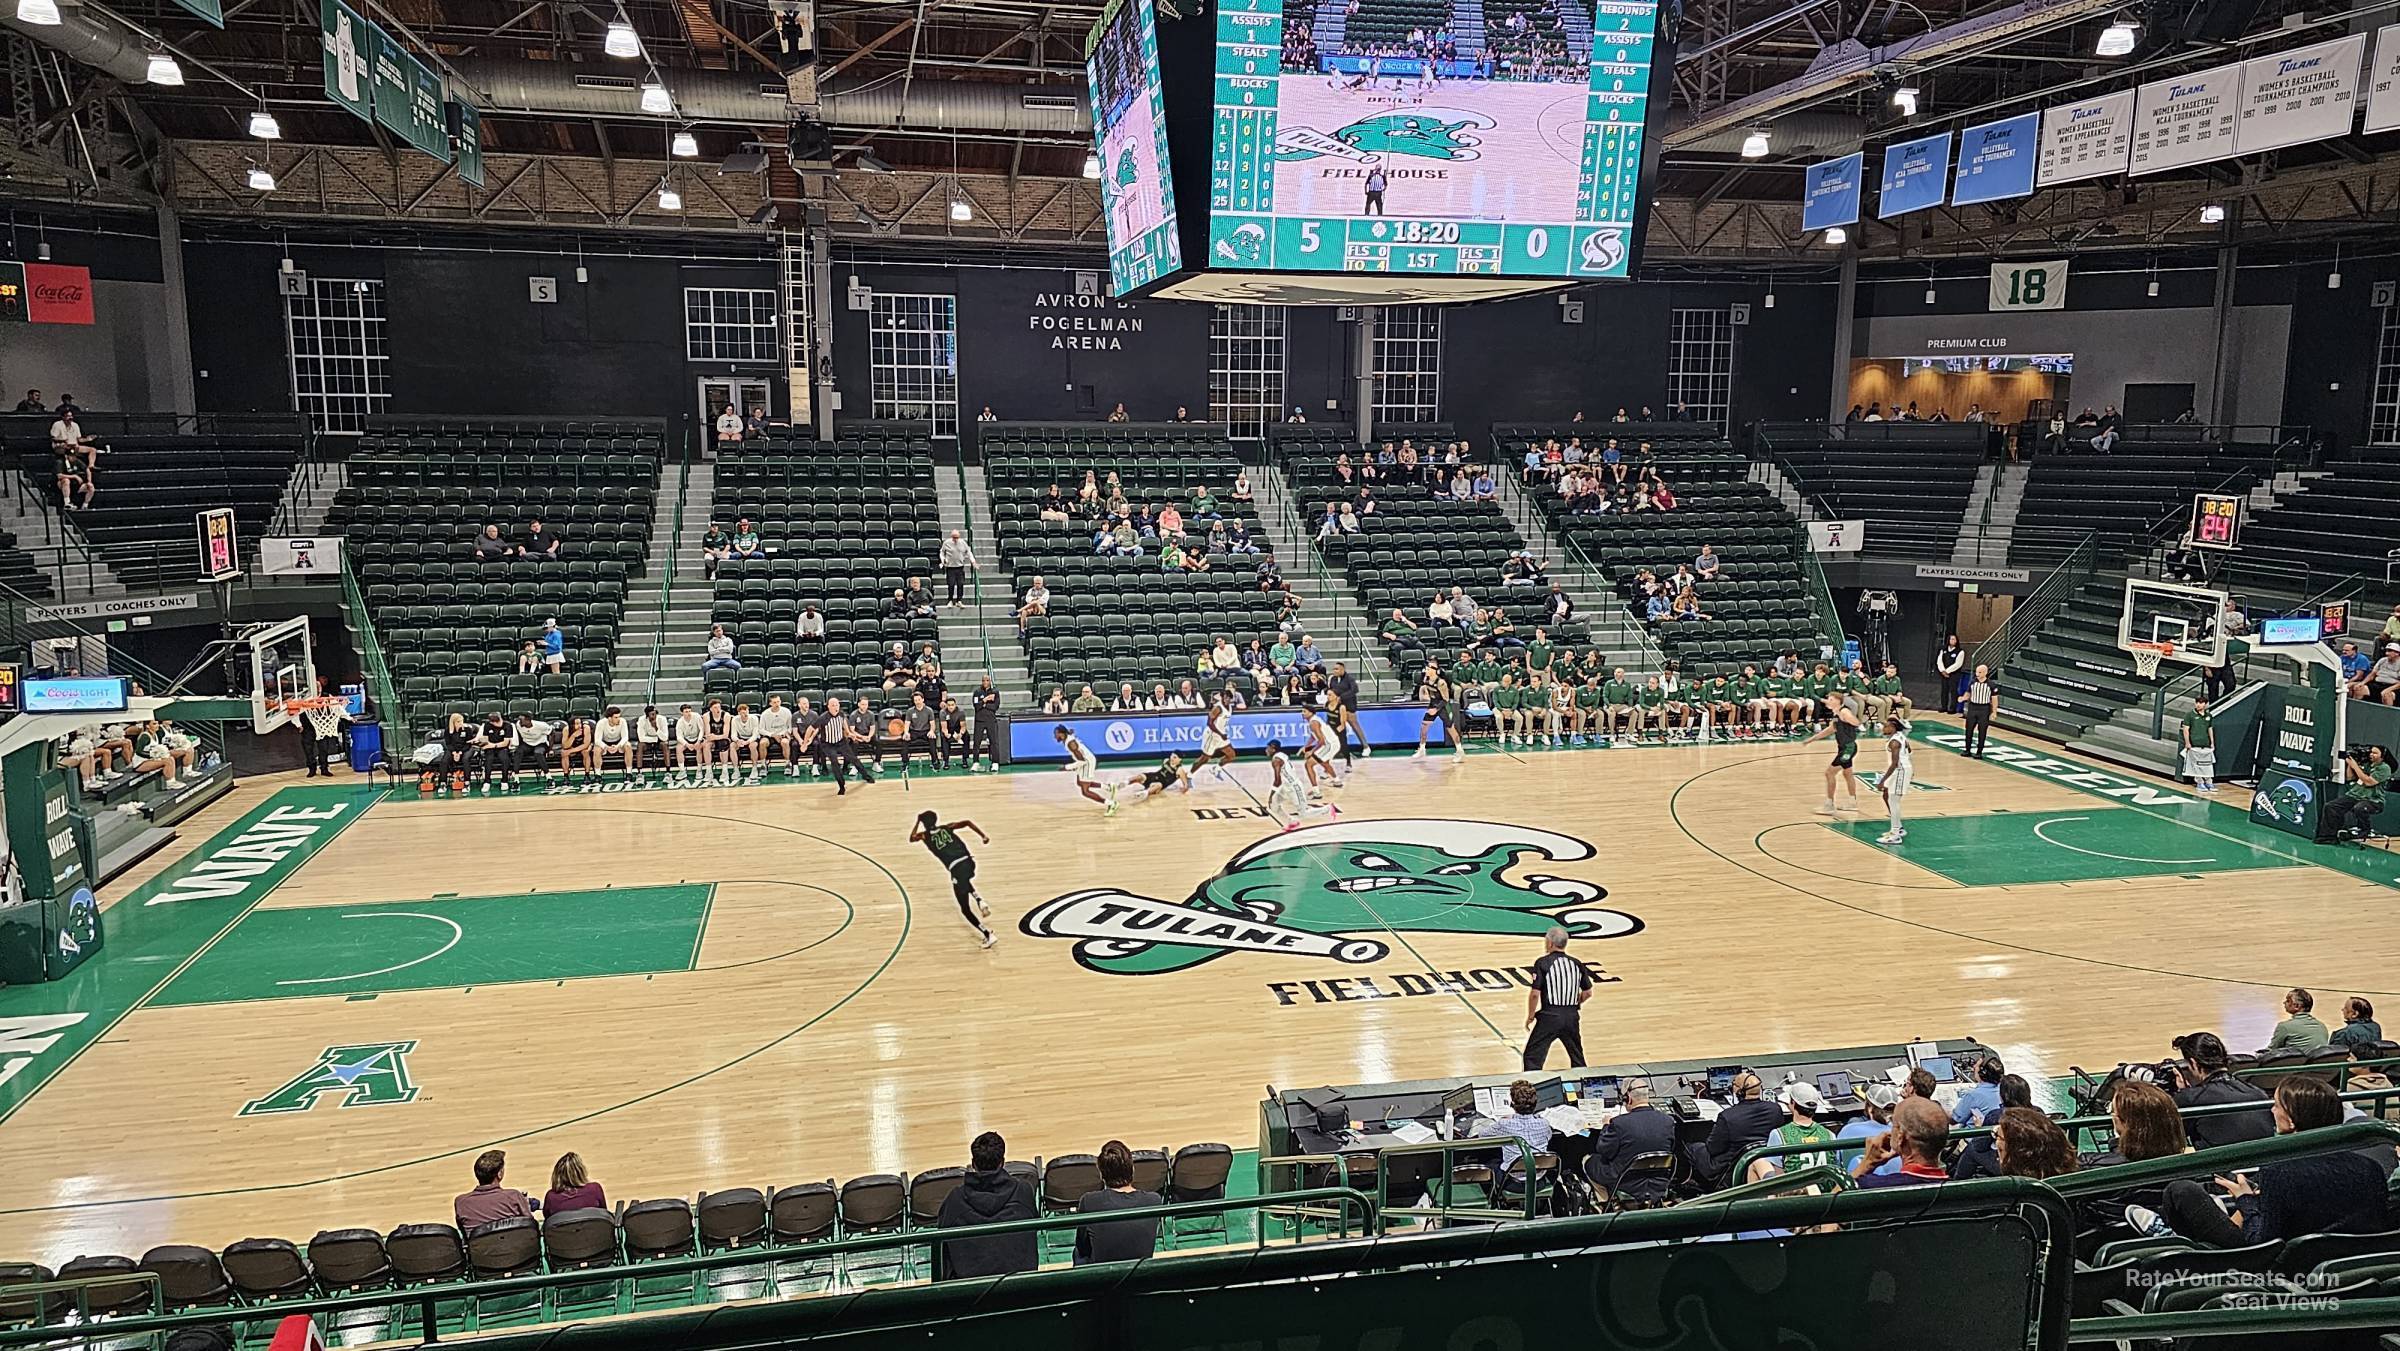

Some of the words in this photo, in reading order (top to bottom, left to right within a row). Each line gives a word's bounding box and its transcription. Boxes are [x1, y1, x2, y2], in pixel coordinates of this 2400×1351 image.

[1601, 5, 1652, 16] REBOUNDS
[1231, 16, 1271, 26] ASSISTS
[1620, 18, 1629, 31] 2
[1247, 29, 1255, 41] 1
[1604, 35, 1641, 45] ASSISTS
[1232, 47, 1268, 57] STEALS
[1616, 49, 1626, 62] 0
[1245, 60, 1255, 73] 0
[1602, 66, 1637, 76] STEALS
[1230, 79, 1269, 89] BLOCKS
[1613, 79, 1623, 92] 0
[2258, 78, 2289, 93] WOMEN'S
[2291, 69, 2336, 86] BASKETBALL
[2375, 81, 2391, 93] 1997
[1244, 92, 1254, 104] 0
[2253, 87, 2296, 105] TOURNAMENT
[2298, 79, 2340, 95] CHAMPIONS
[1599, 95, 1635, 104] BLOCKS
[2152, 104, 2180, 117] WOMEN'S
[2181, 95, 2219, 111] BASKETBALL
[2285, 100, 2302, 112] 2000
[2334, 90, 2351, 101] 2010
[1219, 109, 1232, 119] PL
[1241, 110, 1254, 119] PT
[1265, 111, 1272, 120] F
[1609, 108, 1619, 121] 0
[2156, 115, 2171, 125] NCAA
[2174, 106, 2214, 122] TOURNAMENT
[1220, 124, 1226, 134] 1
[1243, 125, 1251, 136] 0
[1265, 126, 1272, 136] 0
[1585, 125, 1597, 134] PL
[1606, 125, 1619, 135] PT
[1629, 126, 1637, 135] F
[2057, 124, 2081, 136] WOMEN'S
[2082, 117, 2114, 131] BASKETBALL
[1219, 142, 1226, 153] 5
[1243, 144, 1250, 154] 0
[1265, 144, 1271, 154] 0
[1586, 139, 1592, 149] 1
[1607, 140, 1615, 150] 0
[1628, 141, 1636, 151] 0
[1215, 160, 1229, 171] 12
[1242, 161, 1249, 172] 3
[1264, 162, 1270, 172] 0
[1583, 156, 1591, 167] 4
[1606, 157, 1613, 167] 0
[1626, 157, 1634, 168] 0
[1214, 178, 1228, 189] 24
[1241, 179, 1249, 189] 2
[1263, 180, 1270, 190] 0
[1580, 173, 1594, 184] 15
[1604, 174, 1611, 184] 0
[1625, 175, 1631, 185] 1
[1213, 195, 1228, 207] 25
[1240, 197, 1247, 207] 0
[1262, 197, 1269, 208] 0
[1577, 191, 1591, 201] 24
[1602, 191, 1609, 201] 0
[1623, 191, 1630, 202] 0
[1576, 207, 1588, 218] 31
[1600, 208, 1608, 218] 0
[1621, 208, 1628, 219] 0
[1300, 221, 1320, 253] 5
[1393, 221, 1460, 242] 18:20
[1527, 228, 1548, 258] 0
[1347, 246, 1370, 257] FLS
[1378, 246, 1387, 257] 0
[1461, 248, 1483, 259] FLS
[1492, 249, 1498, 260] 1
[1347, 260, 1365, 271] TO
[1376, 261, 1386, 271] 4
[1407, 253, 1439, 268] 1ST
[1460, 261, 1479, 273] TO
[1490, 262, 1498, 273] 4
[287, 277, 300, 292] R
[1081, 279, 1093, 293] A
[2008, 268, 2047, 305] 18
[538, 285, 548, 299] S
[2378, 289, 2389, 304] D
[855, 294, 865, 307] T
[1035, 293, 1105, 309] AVRON
[1346, 306, 1354, 318] B
[1569, 308, 1579, 321] C
[1735, 310, 1745, 322] D
[1029, 316, 1142, 332] FOGELMAN
[1051, 335, 1122, 350] ARENA
[1927, 339, 1977, 349] PREMIUM
[1980, 338, 2007, 348] CLUB
[2202, 501, 2234, 517] 18:20
[2202, 515, 2228, 540] 24
[1921, 568, 1955, 576] PLAYERS
[1960, 570, 1999, 578] COACHES
[37, 606, 87, 618] PLAYERS
[105, 597, 156, 612] COACHES
[160, 597, 187, 607] ONLY
[80, 688, 110, 697] LIGHT
[2284, 704, 2314, 727] ROLL
[1143, 724, 1245, 743] HANCK
[2280, 730, 2315, 754] WAVE
[1926, 734, 2199, 806] GREEN
[667, 777, 762, 790] WAVE
[46, 794, 68, 825] ROLL
[47, 826, 76, 860] WAVE
[144, 803, 349, 906] WAVE
[1086, 902, 1304, 947] TULANE
[1266, 961, 1623, 1005] FIELDHOUE
